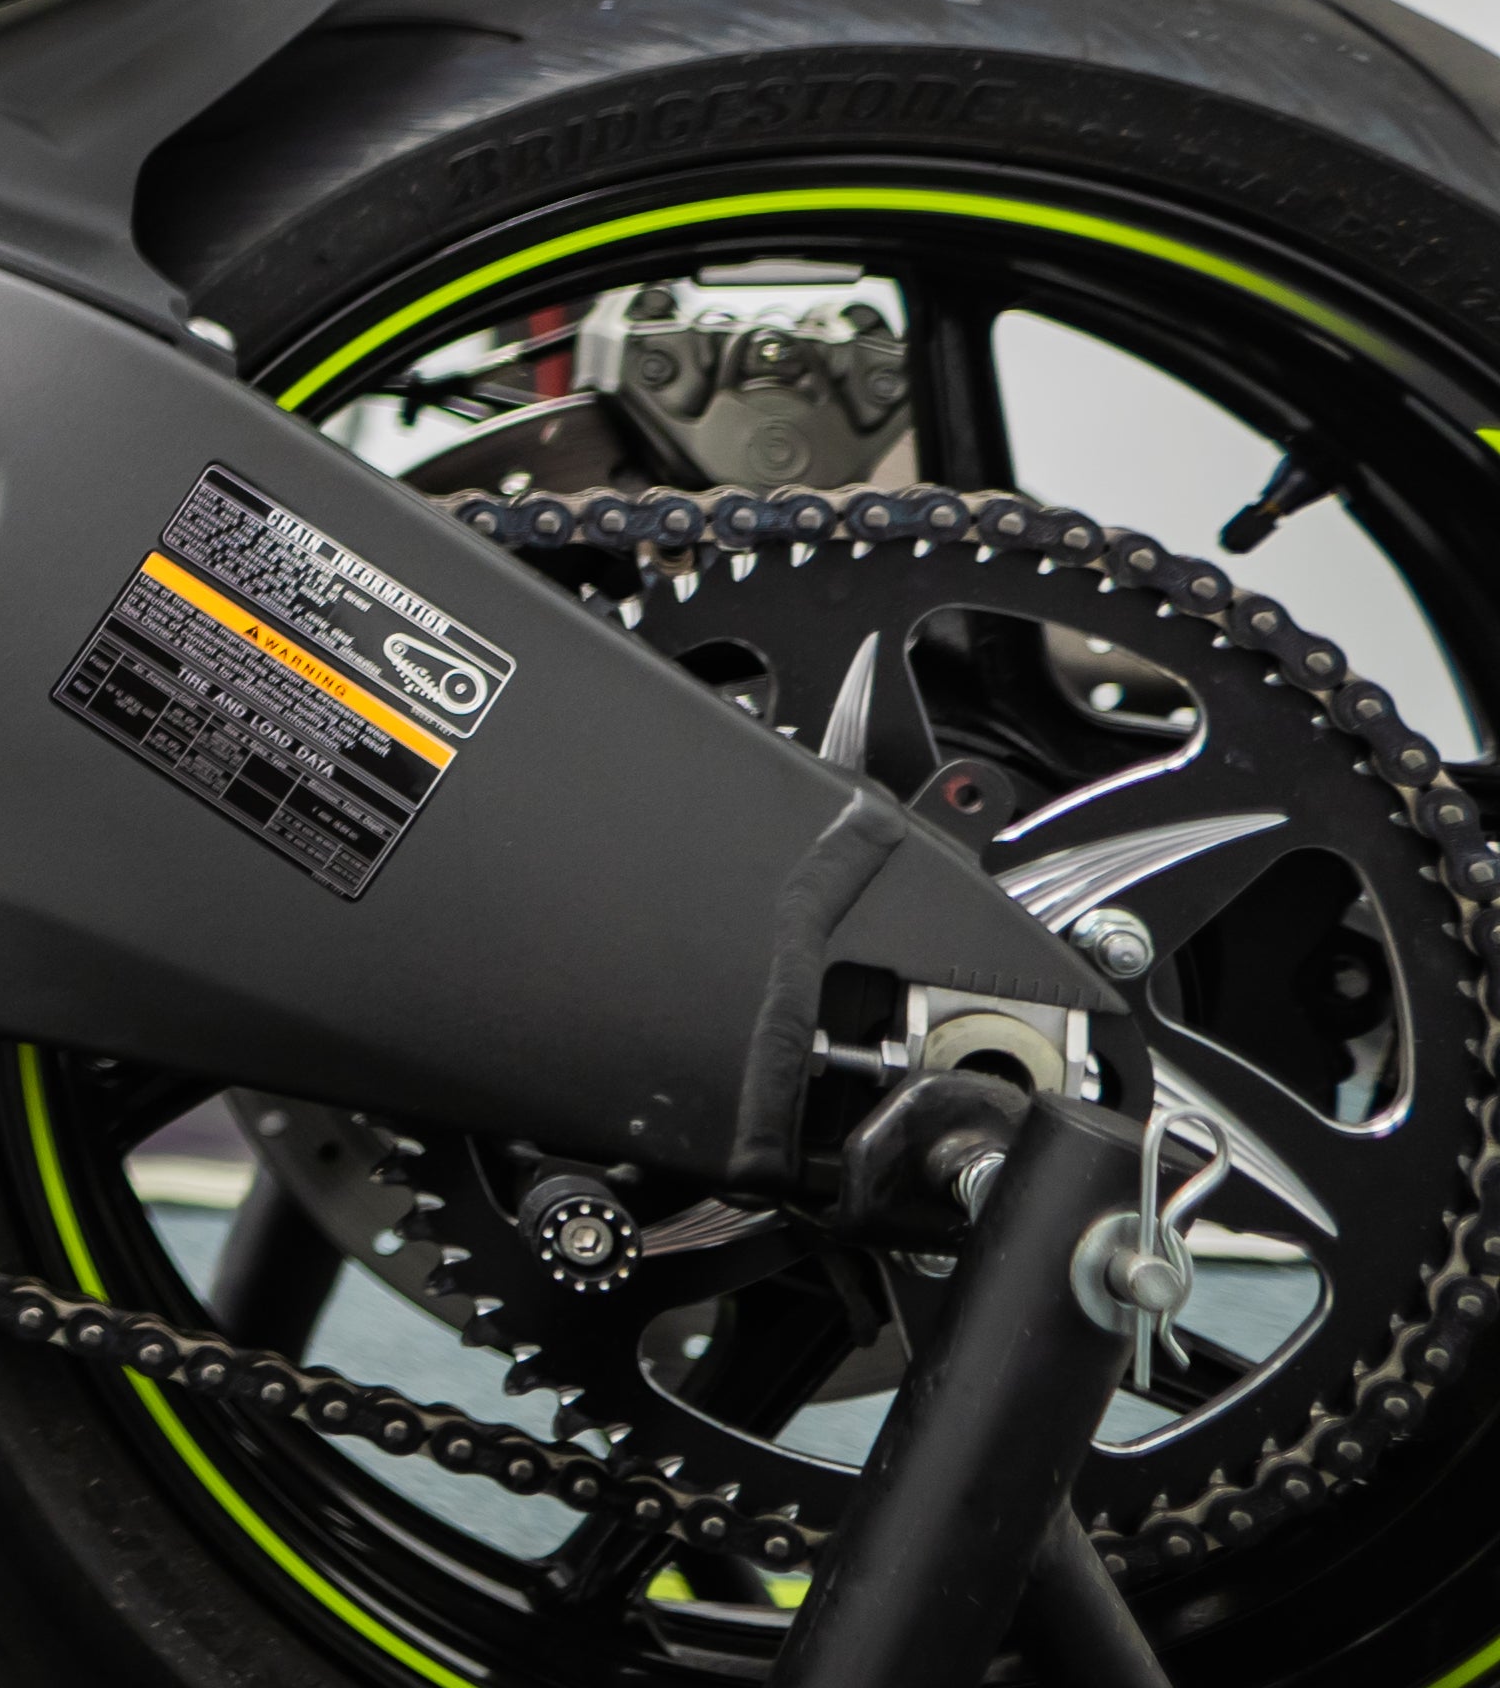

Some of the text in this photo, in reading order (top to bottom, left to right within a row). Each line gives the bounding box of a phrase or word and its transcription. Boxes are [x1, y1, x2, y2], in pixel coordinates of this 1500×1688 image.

[264, 506, 451, 637] CHAIN INFORMATION
[175, 664, 213, 697] TIRE
[211, 688, 247, 719] AND
[249, 713, 294, 750] LOAD
[294, 743, 337, 779] DATA
[263, 637, 347, 697] WARNING
